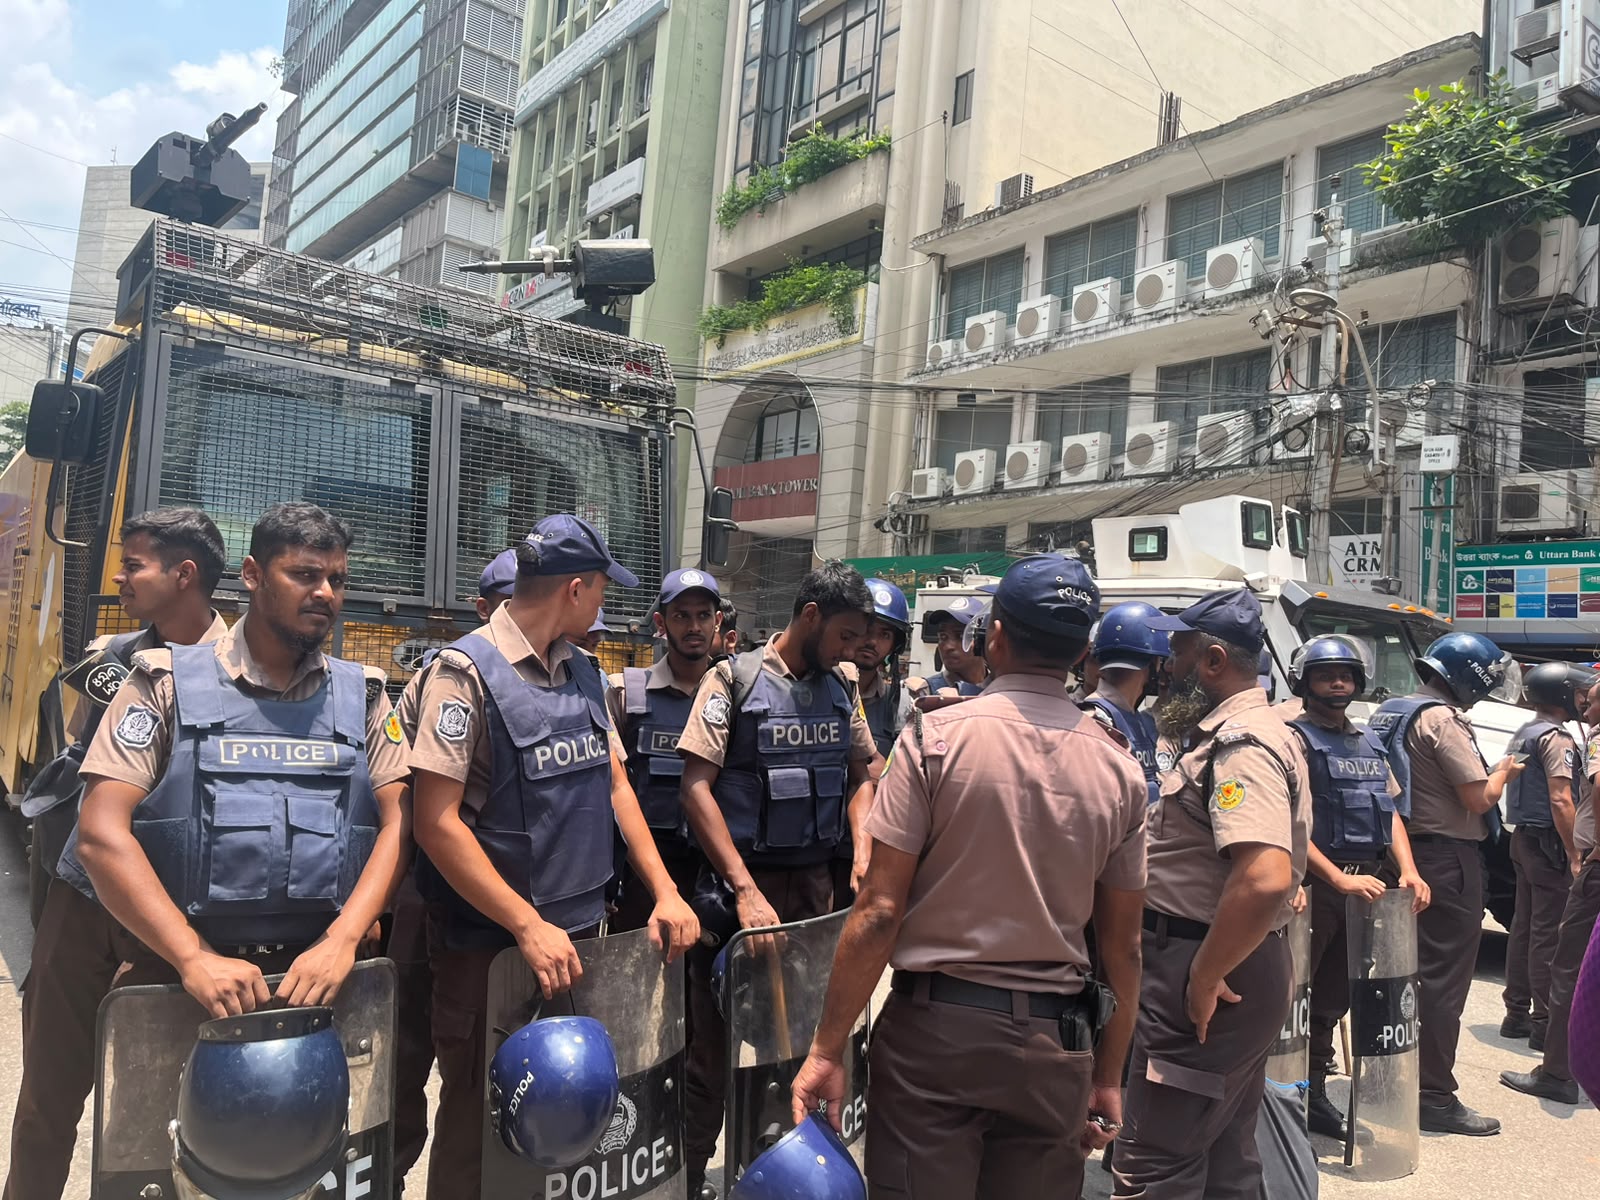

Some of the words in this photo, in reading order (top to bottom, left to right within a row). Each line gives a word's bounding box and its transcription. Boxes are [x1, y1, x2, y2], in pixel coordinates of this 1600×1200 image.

[778, 478, 818, 495] TOWER
[1540, 550, 1569, 559] Uttara
[1571, 549, 1596, 558] Bank
[1057, 586, 1092, 605] POLICE
[1470, 661, 1494, 687] POLICE
[773, 722, 840, 746] POLICE
[231, 743, 326, 761] POLICE
[534, 734, 606, 770] POLICE
[1337, 759, 1382, 776] POLICE
[507, 1071, 535, 1116] POLICE
[545, 1136, 665, 1200] POLICE
